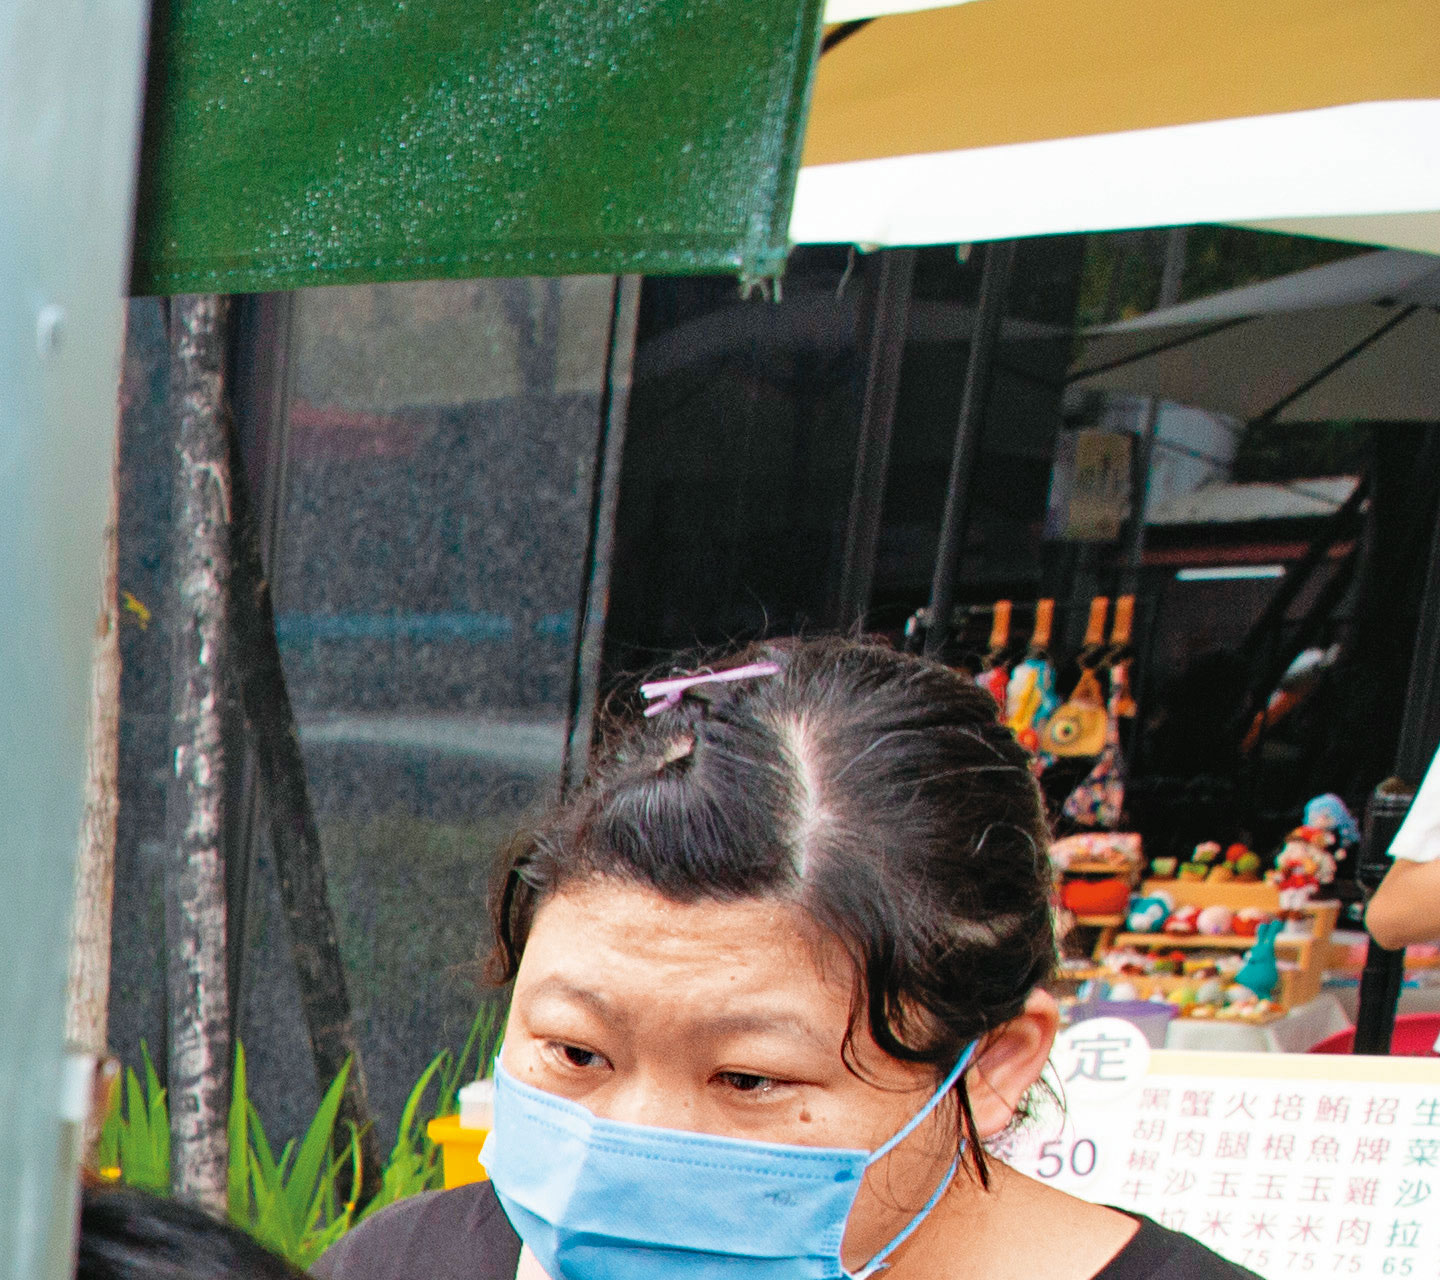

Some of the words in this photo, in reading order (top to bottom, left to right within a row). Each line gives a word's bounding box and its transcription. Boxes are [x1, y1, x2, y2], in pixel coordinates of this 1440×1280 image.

[1065, 1033, 1132, 1083] 定
[1120, 1087, 1172, 1201] 黑胡椒牛
[1199, 1090, 1258, 1238] 火腿玉米
[1241, 1093, 1306, 1241] 培根玉米
[1287, 1094, 1350, 1243] 鮪魚玉米
[1335, 1096, 1400, 1247] 招牌雞肉
[1381, 1255, 1414, 1277] 65
